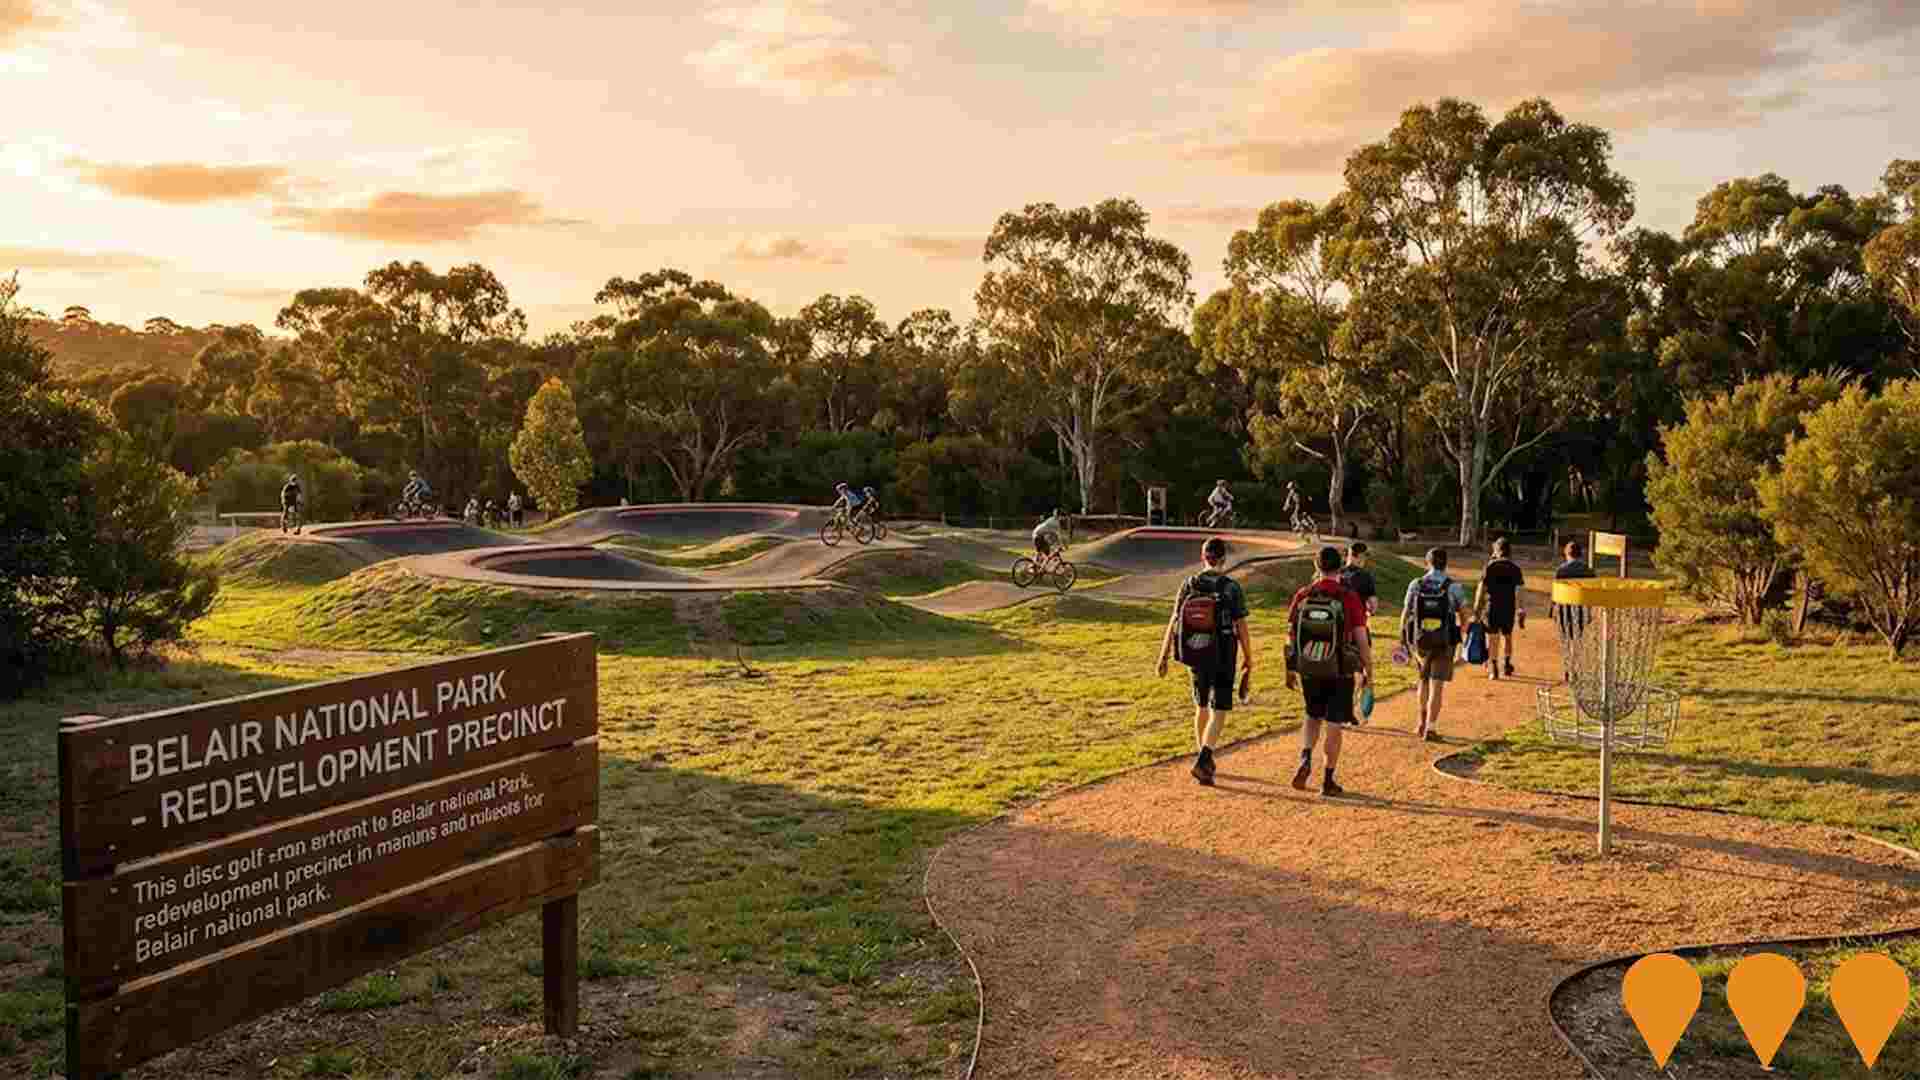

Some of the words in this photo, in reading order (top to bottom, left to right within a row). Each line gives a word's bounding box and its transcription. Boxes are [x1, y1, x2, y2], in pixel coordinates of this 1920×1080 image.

[129, 720, 264, 783] BELAIR
[275, 687, 429, 750] NATIONAL
[436, 669, 506, 714] PARK
[131, 815, 147, 826] -
[160, 728, 439, 829] REDEVELOPMENT
[447, 697, 568, 756] PRECINCT
[133, 874, 177, 904] This
[183, 862, 224, 889] disc
[227, 847, 265, 881] golf
[372, 814, 387, 832] to
[391, 797, 435, 828] Belair
[439, 780, 497, 814] national
[134, 870, 280, 934] redevelopment
[285, 844, 353, 892] precinct
[356, 843, 372, 864] in
[440, 811, 468, 838] and
[135, 923, 200, 964] Belair
[205, 895, 281, 939] national
[286, 881, 332, 918] park.
